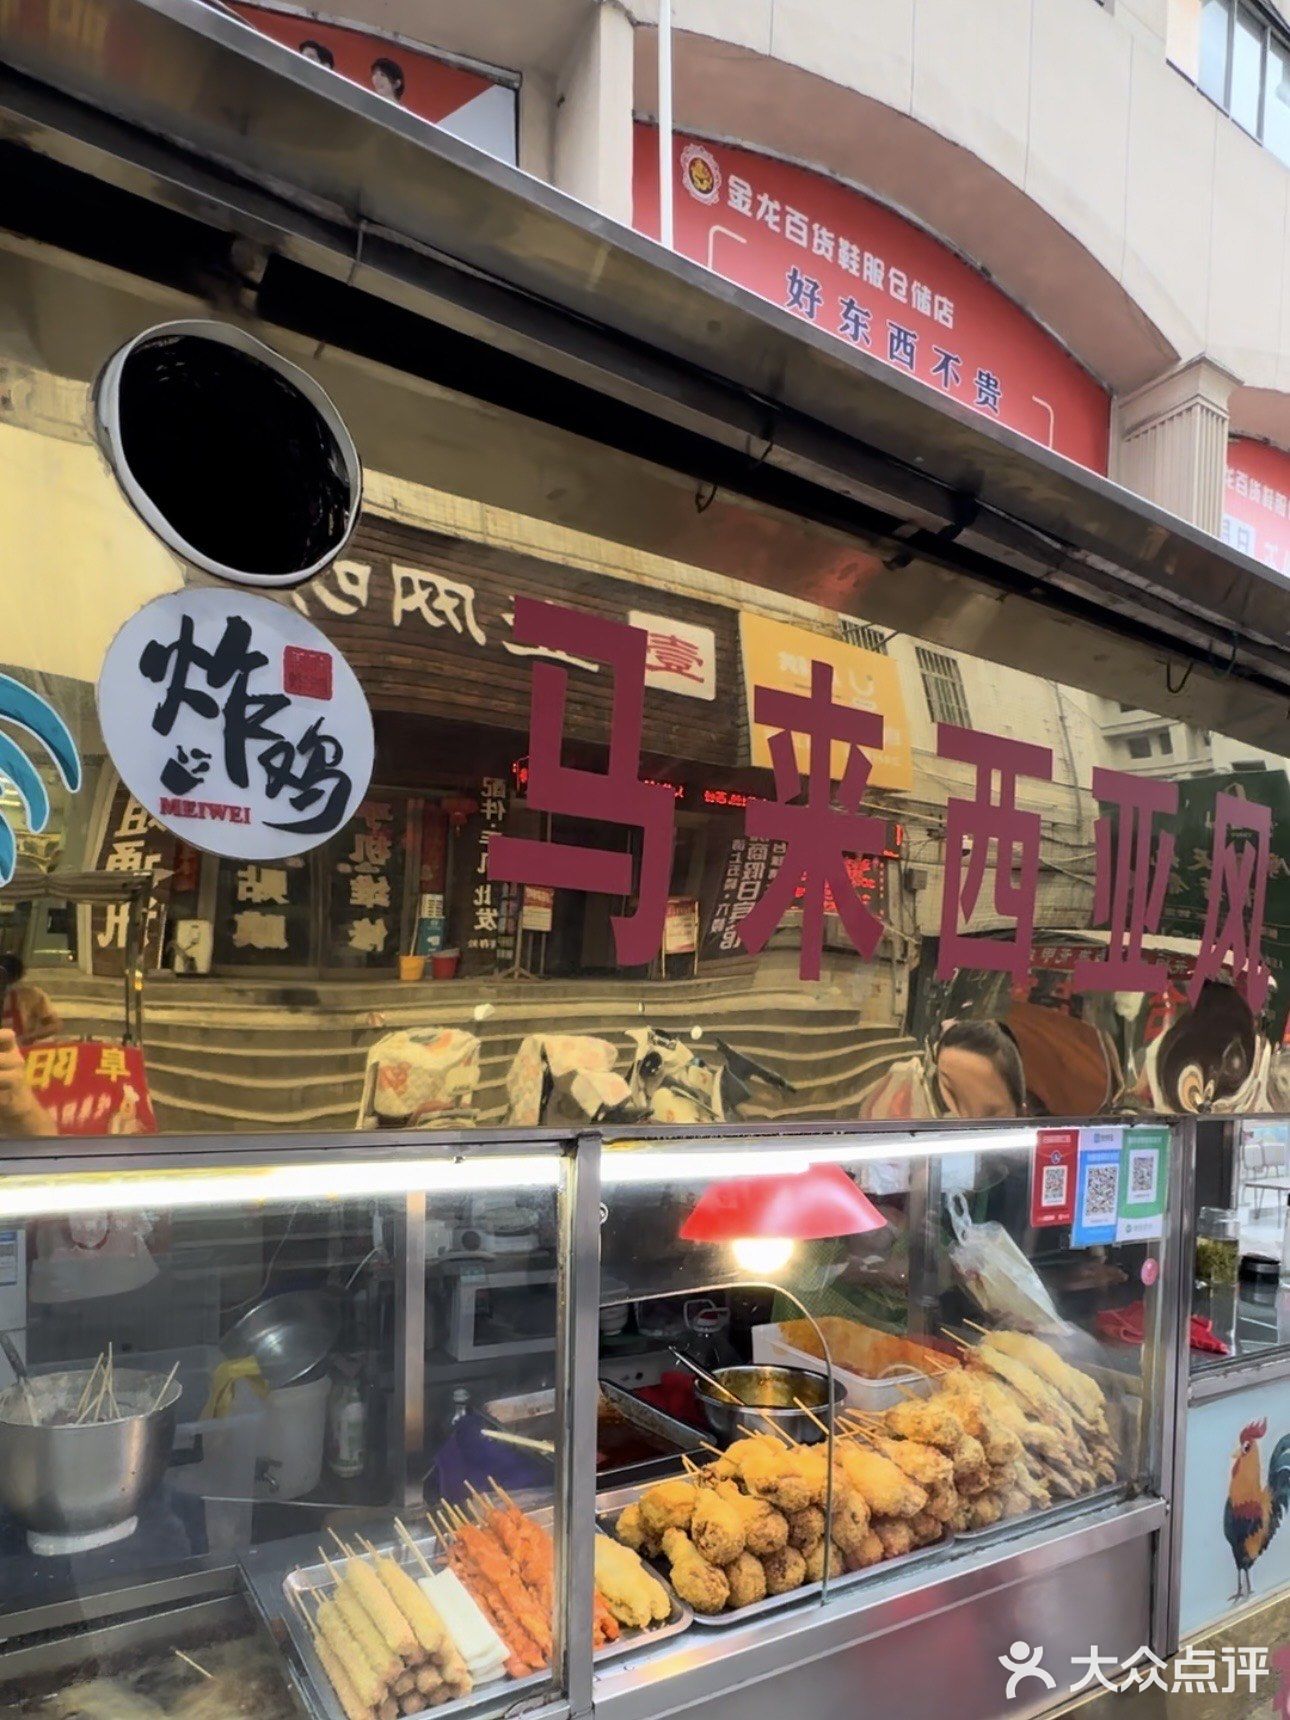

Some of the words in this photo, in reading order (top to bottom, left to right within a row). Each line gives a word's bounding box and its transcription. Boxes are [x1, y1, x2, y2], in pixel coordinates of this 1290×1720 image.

[727, 174, 955, 329] 金龙百货鞋服仓储店
[785, 265, 1002, 414] 好东西不贵
[139, 614, 352, 835] 炸鸡
[159, 796, 251, 826] MEIWEI
[487, 595, 1272, 1017] 马来西亚风
